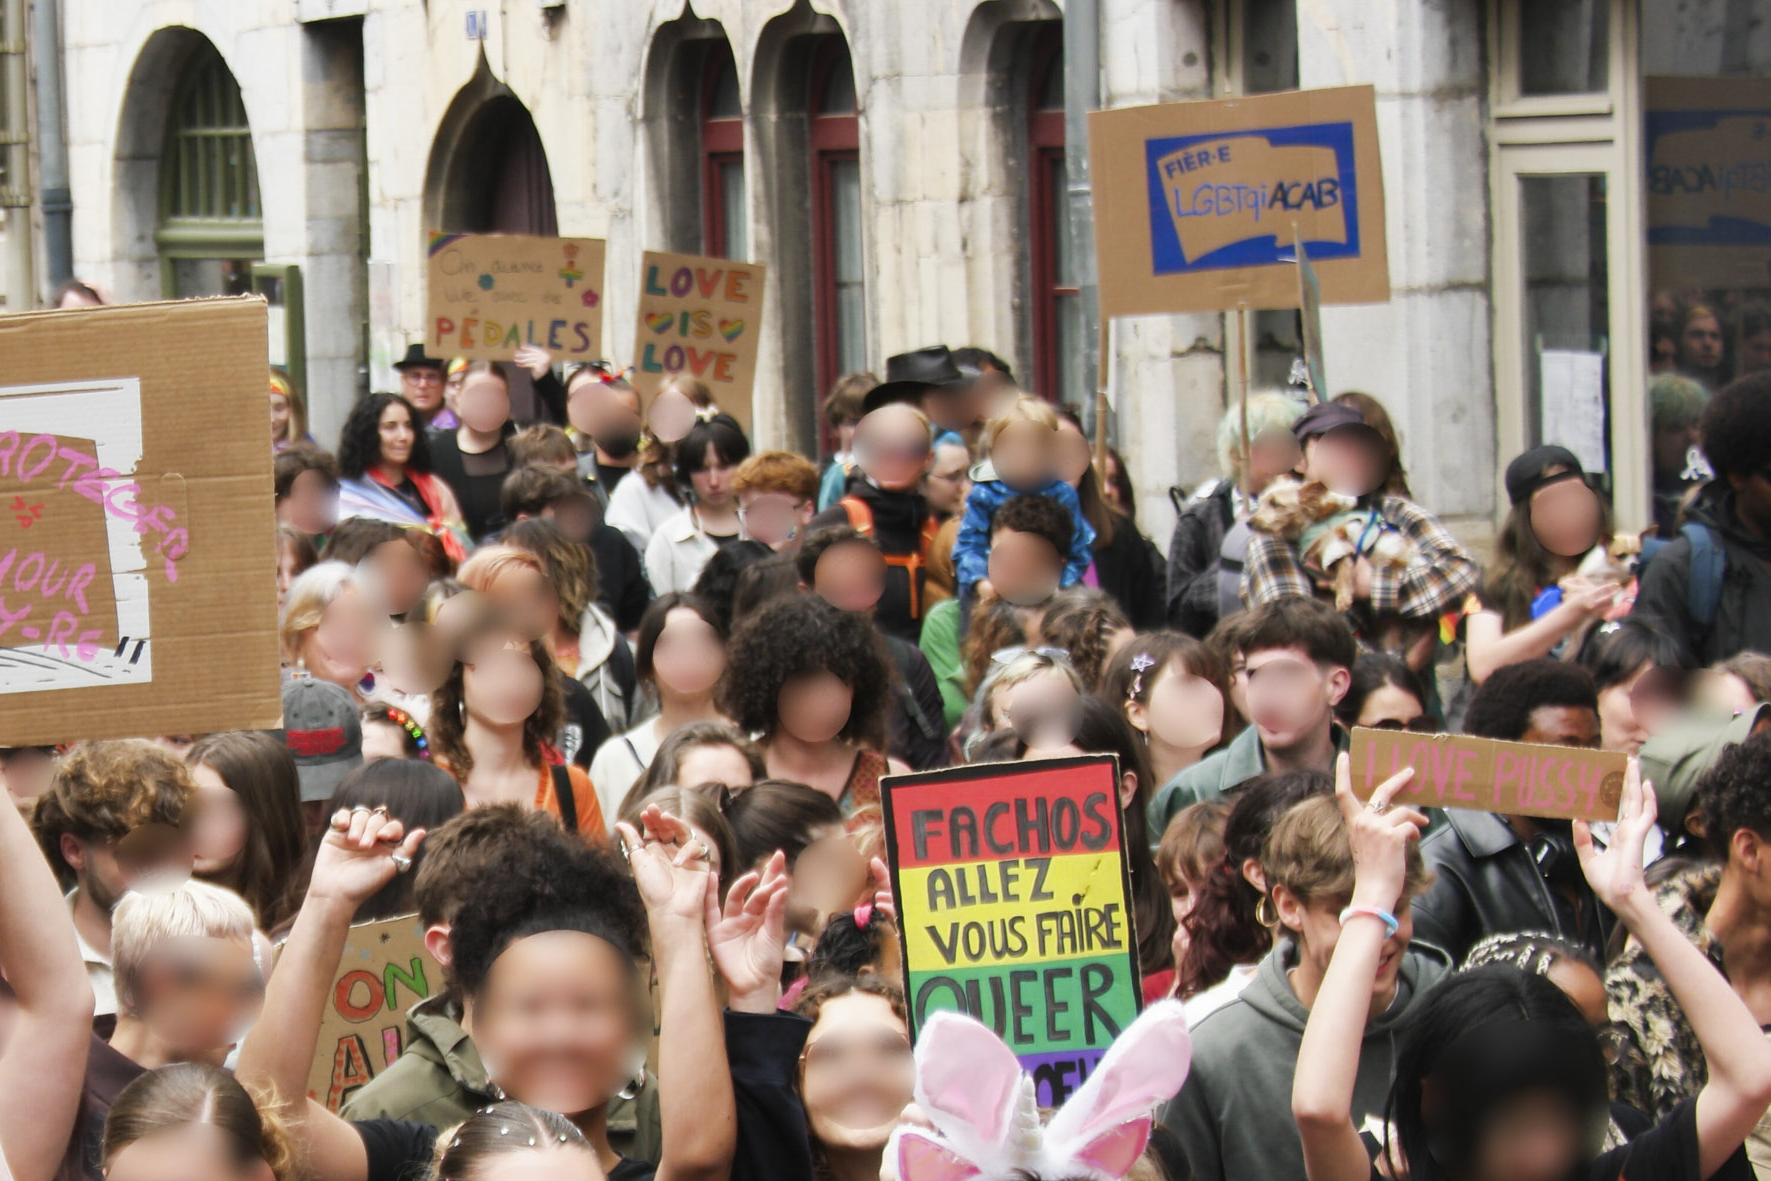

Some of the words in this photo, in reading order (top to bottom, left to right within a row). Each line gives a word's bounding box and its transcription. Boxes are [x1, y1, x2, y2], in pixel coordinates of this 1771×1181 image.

[645, 265, 751, 304] LOVE
[435, 307, 591, 354] PÉDALES
[679, 309, 714, 341] IS
[641, 342, 737, 383] LOVE
[1364, 739, 1376, 789] I
[1390, 740, 1481, 802] LOVE
[1493, 751, 1604, 815] PUSSY
[911, 792, 1113, 861] FACHOS
[926, 857, 1054, 913] ALLEZ
[924, 914, 1029, 966] VOUS
[333, 956, 429, 1024] ON
[915, 962, 1124, 1047] QUEER
